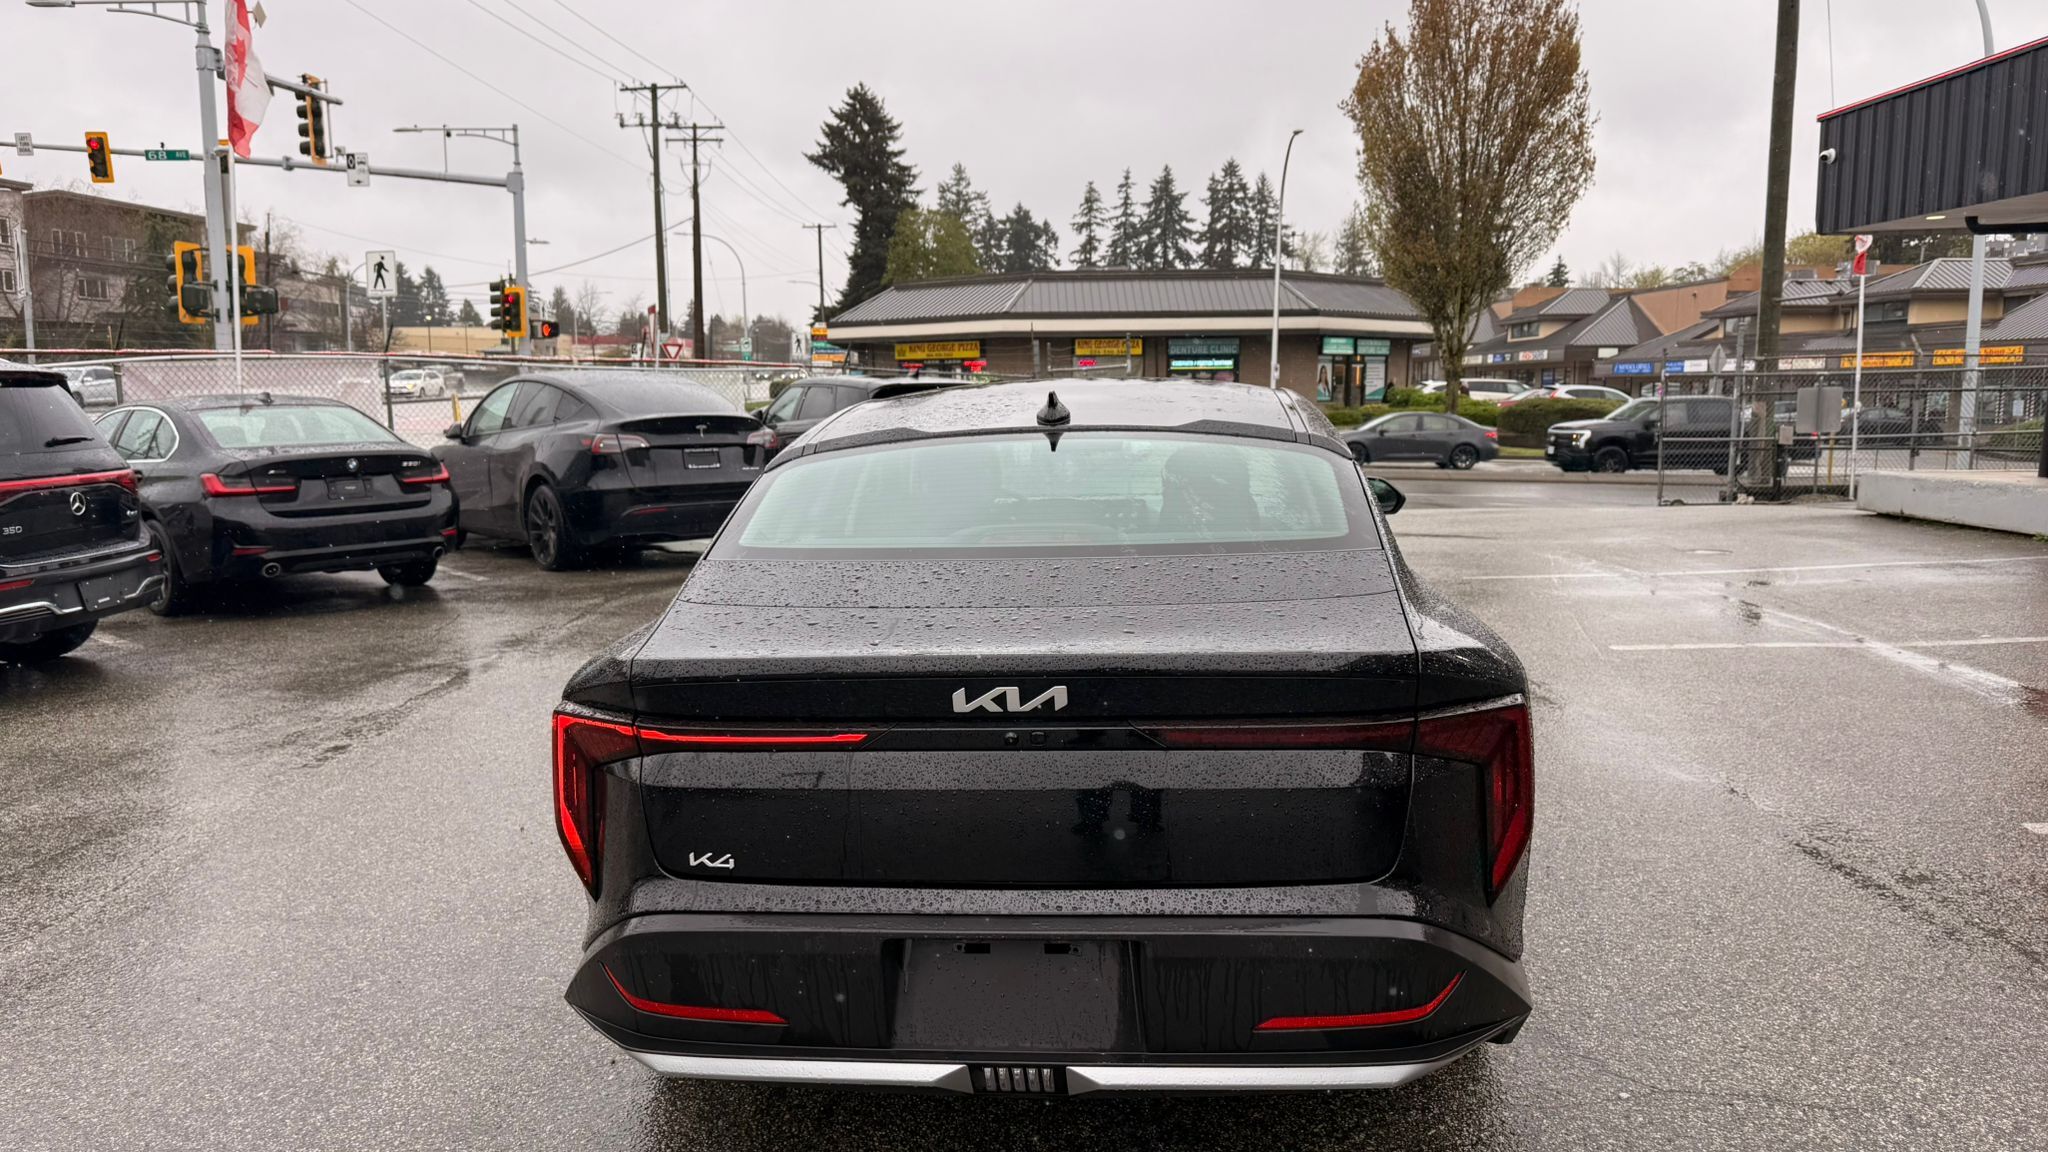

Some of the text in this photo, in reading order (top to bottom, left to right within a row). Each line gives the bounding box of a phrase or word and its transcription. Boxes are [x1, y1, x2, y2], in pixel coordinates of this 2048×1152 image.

[148, 150, 168, 160] 68
[908, 342, 979, 352] KING GEORGE PIZZA
[1169, 345, 1238, 354] DENTURE CLINIC
[2, 525, 22, 535] 350
[952, 685, 1069, 713] KIA
[688, 851, 735, 870] K4
